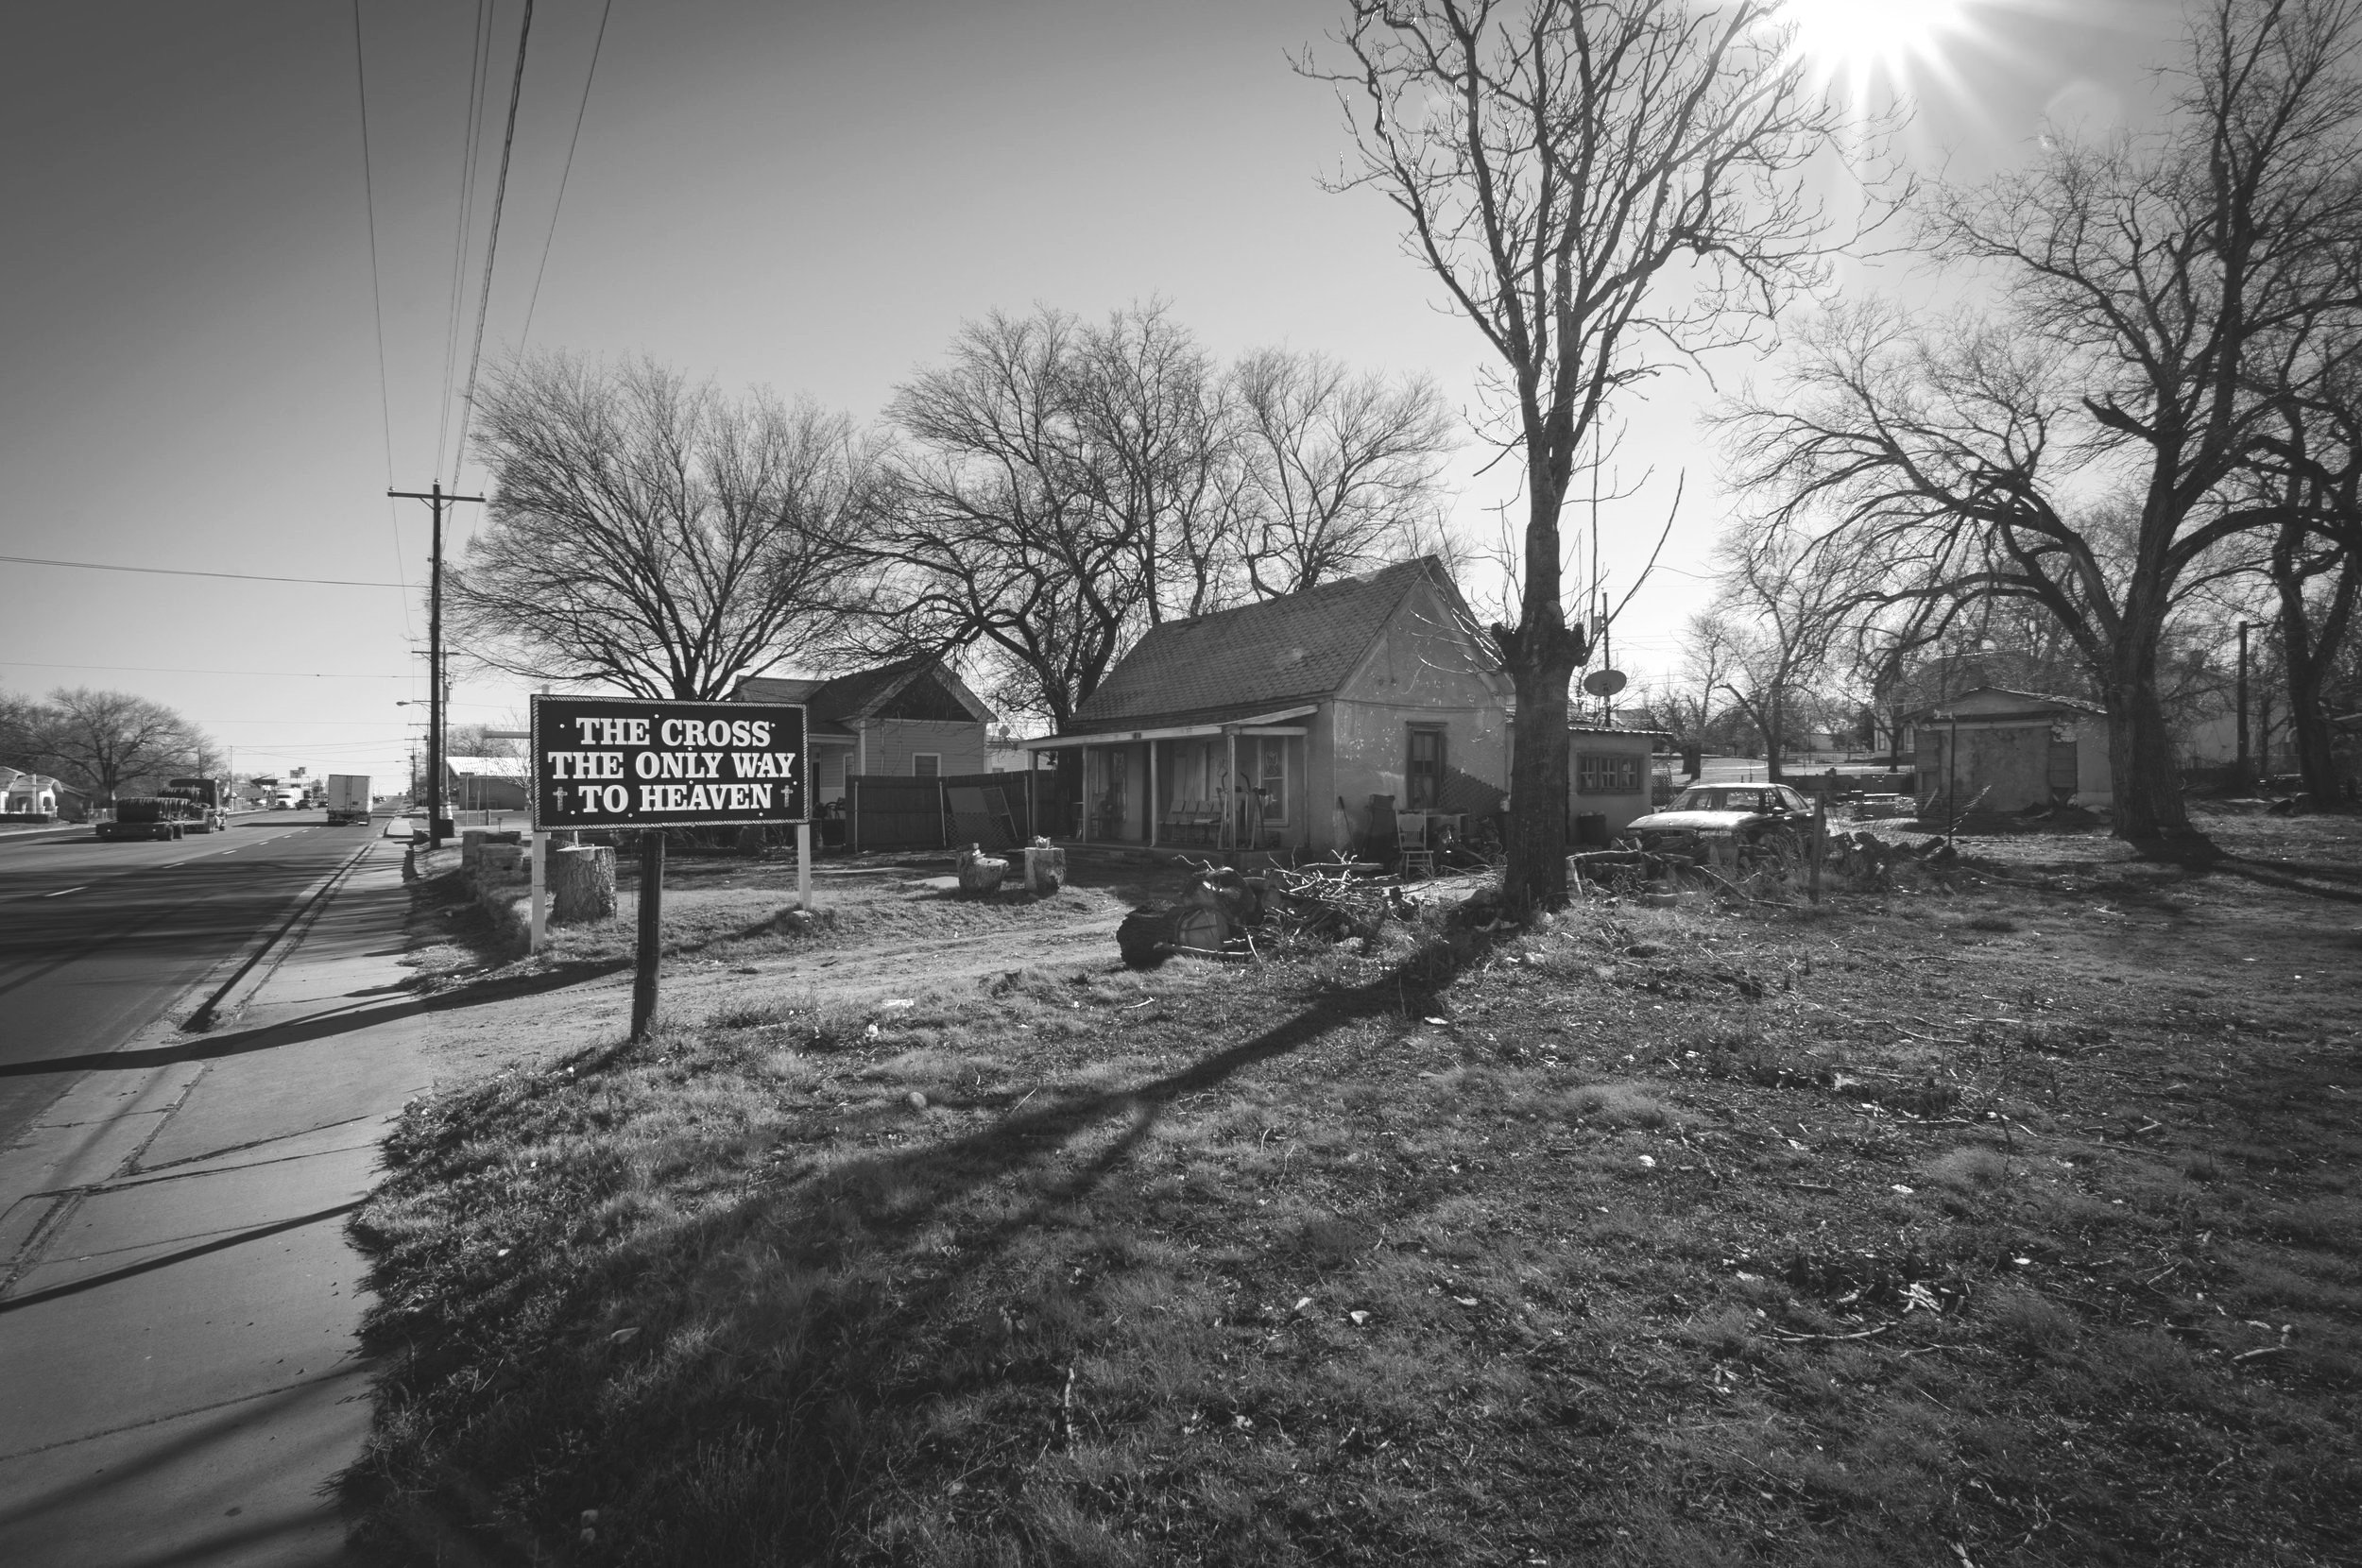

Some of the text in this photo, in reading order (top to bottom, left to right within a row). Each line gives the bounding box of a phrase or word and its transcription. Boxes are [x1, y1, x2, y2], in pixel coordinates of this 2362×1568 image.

[576, 718, 770, 747] THE CROSS
[548, 752, 796, 779] THE ONLY WAY
[578, 784, 773, 813] TO HEAVEN
